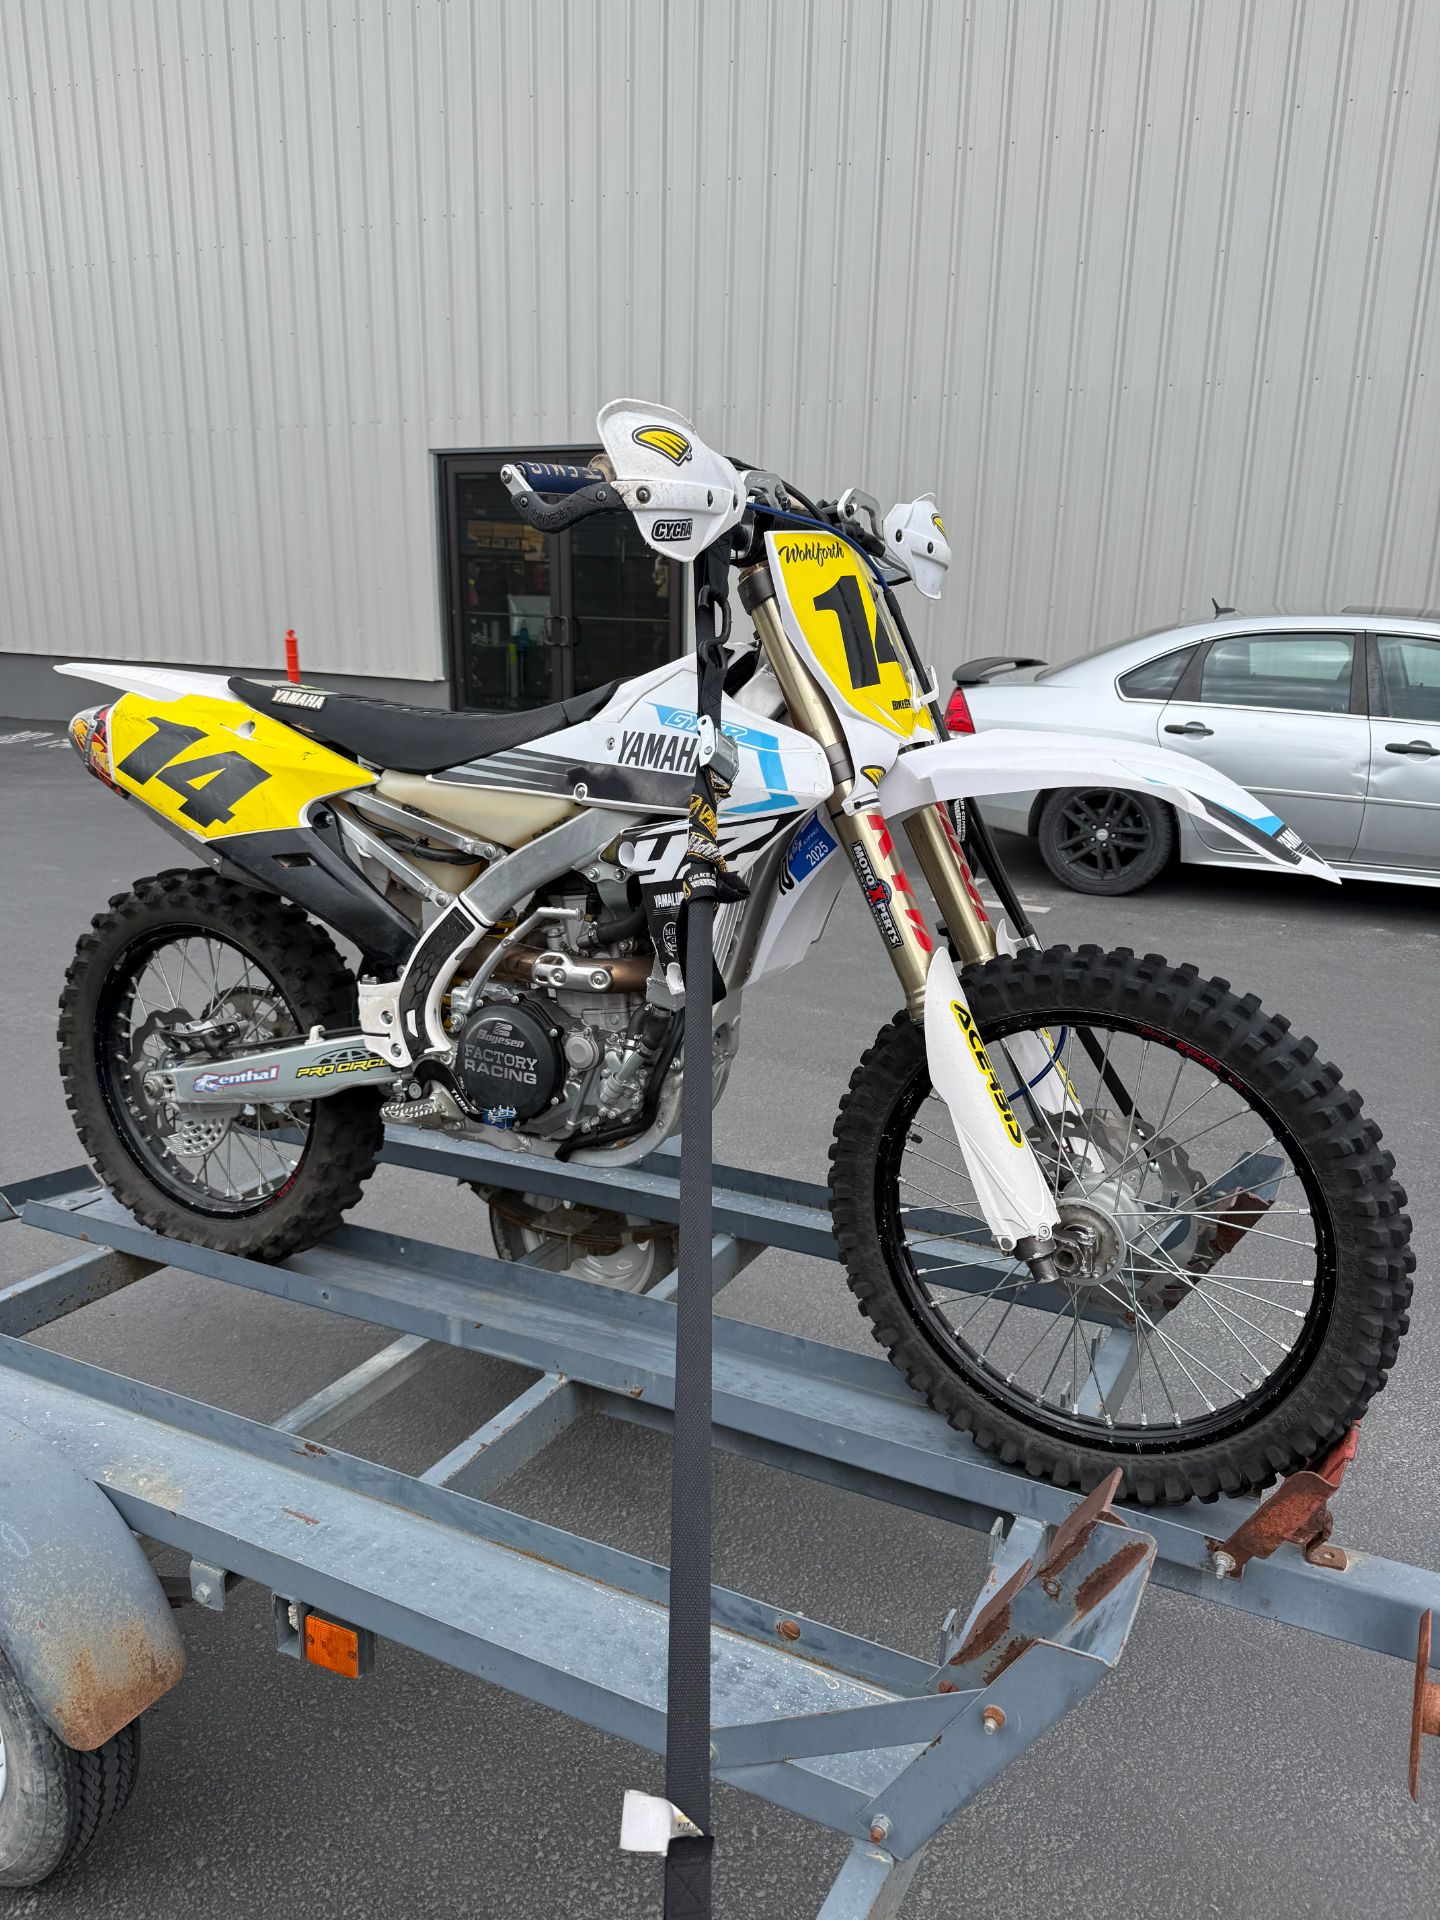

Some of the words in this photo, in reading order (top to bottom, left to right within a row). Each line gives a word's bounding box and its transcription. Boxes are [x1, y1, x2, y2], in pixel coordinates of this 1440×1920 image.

[271, 689, 326, 709] YAMAHA
[617, 730, 700, 774] YAMAH
[117, 716, 272, 827] 14
[805, 841, 829, 867] 2025
[464, 1043, 538, 1071] FACTORY
[194, 1067, 278, 1093] Renthal
[297, 1064, 333, 1079] PRO
[464, 1058, 537, 1085] RACING
